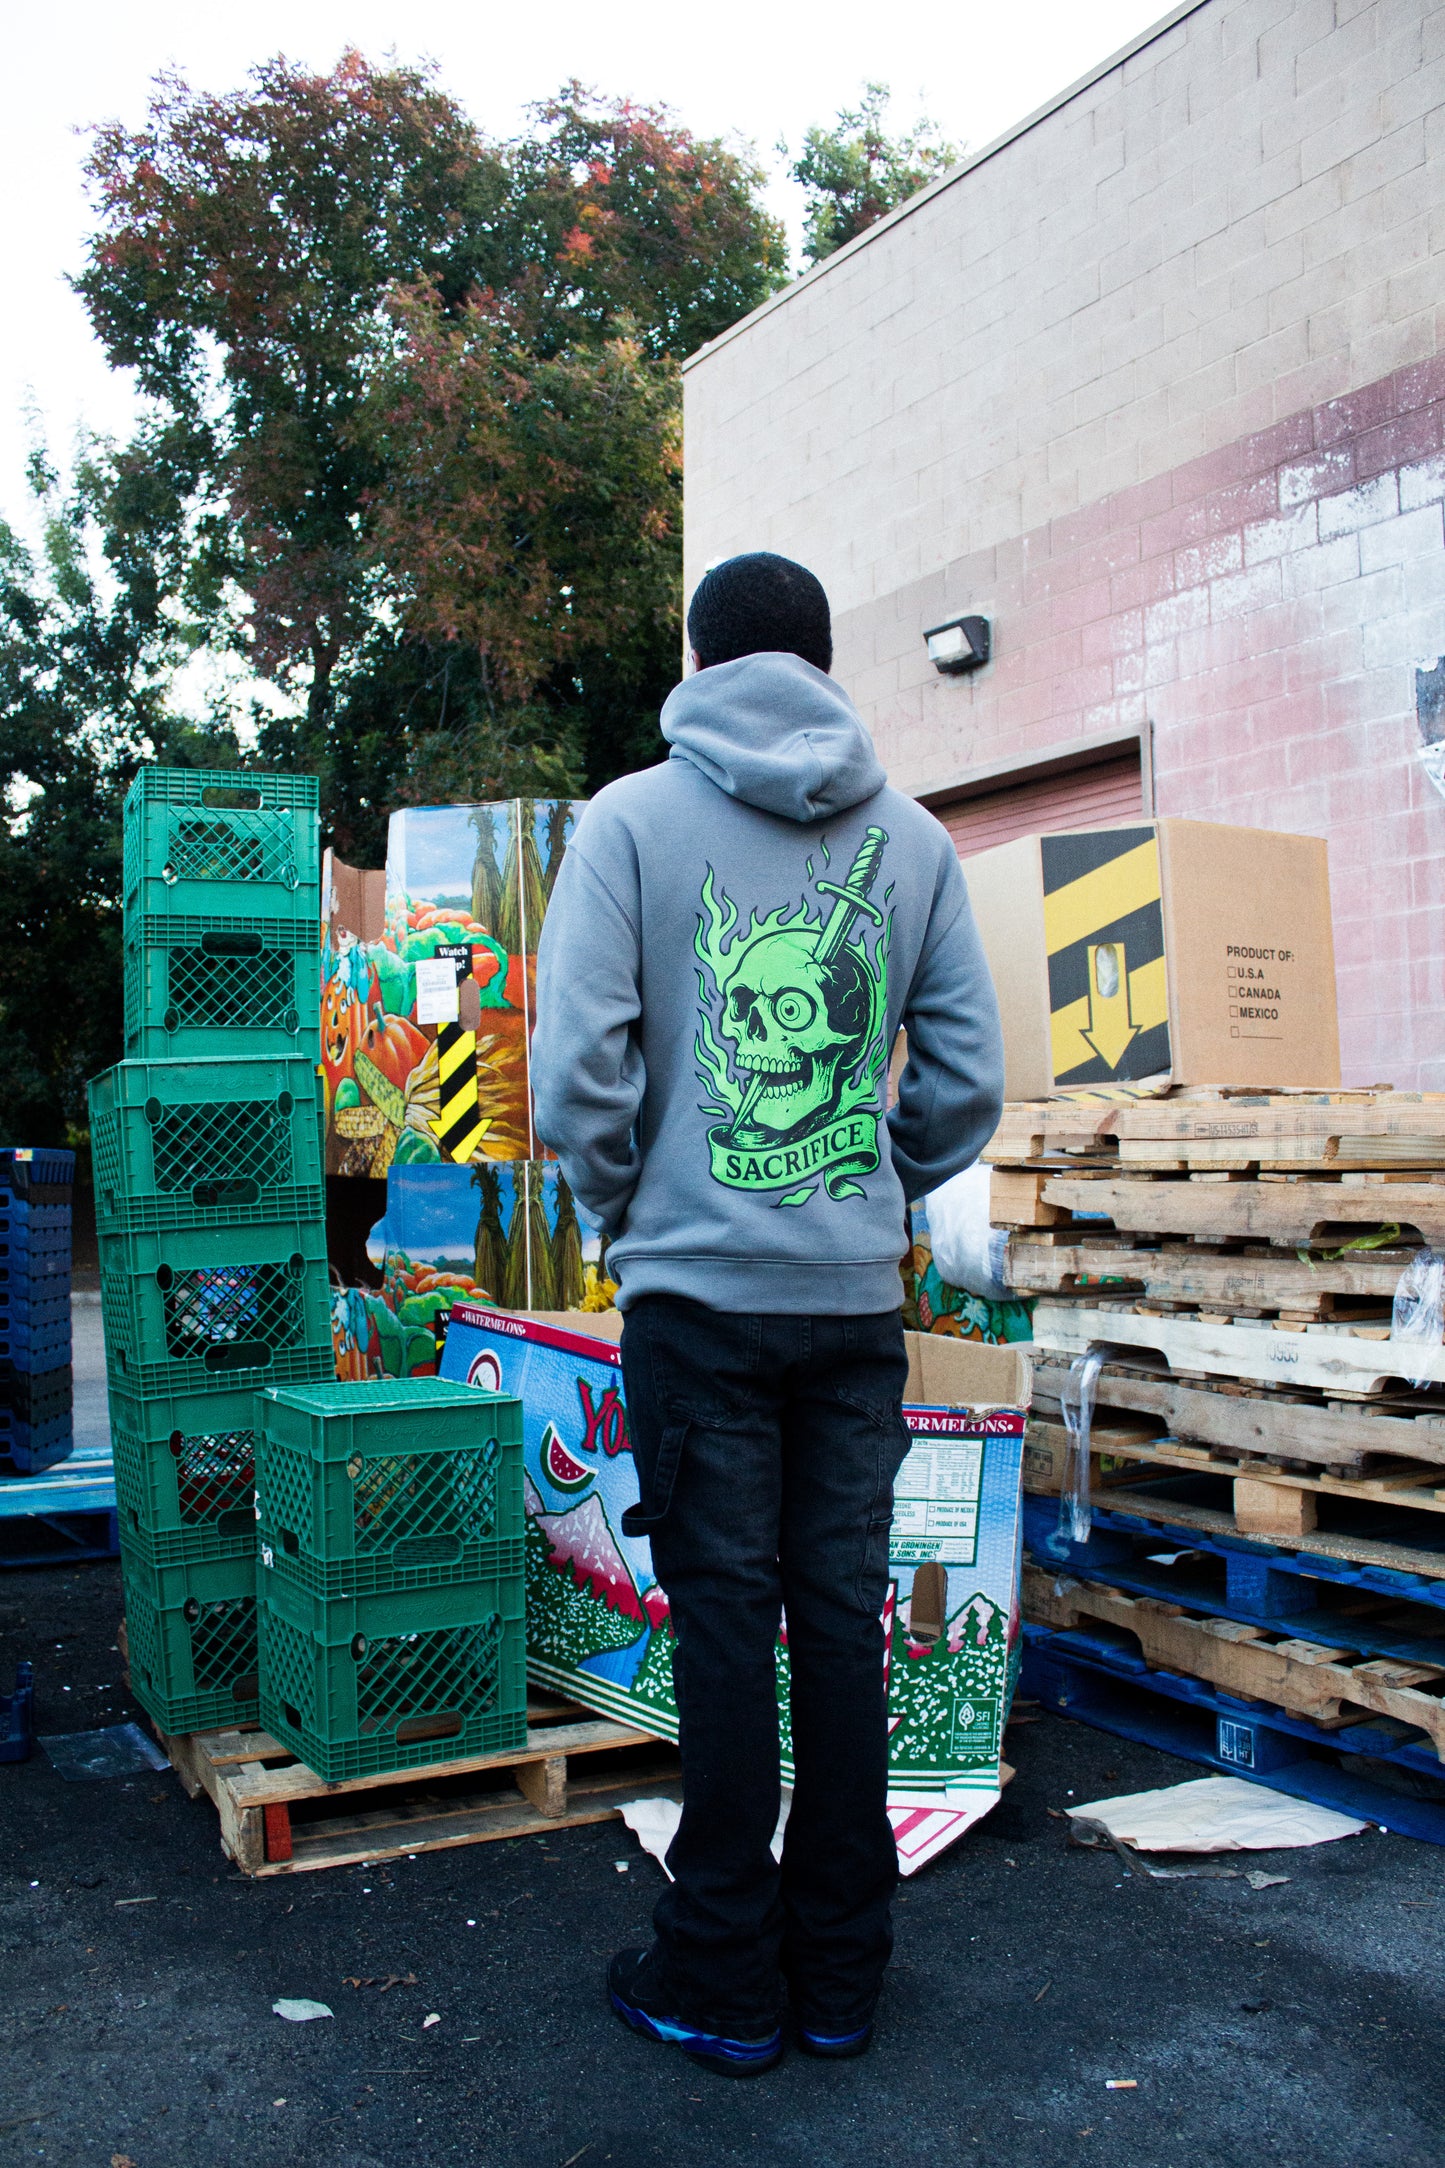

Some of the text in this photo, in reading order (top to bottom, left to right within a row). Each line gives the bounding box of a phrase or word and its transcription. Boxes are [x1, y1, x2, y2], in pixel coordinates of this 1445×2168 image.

[439, 946, 468, 956] Watch
[1227, 946, 1294, 962] PRODUCT OF:
[1237, 967, 1264, 979] U.S.A
[1239, 987, 1281, 1000] CANADA
[1240, 1007, 1278, 1020] MEXICO
[726, 1122, 864, 1181] SACRIFICE
[465, 1311, 525, 1336] WATERMELONS
[904, 1416, 1008, 1433] ERMELONS
[900, 1541, 941, 1550] GRONINGEN
[976, 1711, 990, 1721] SFI
